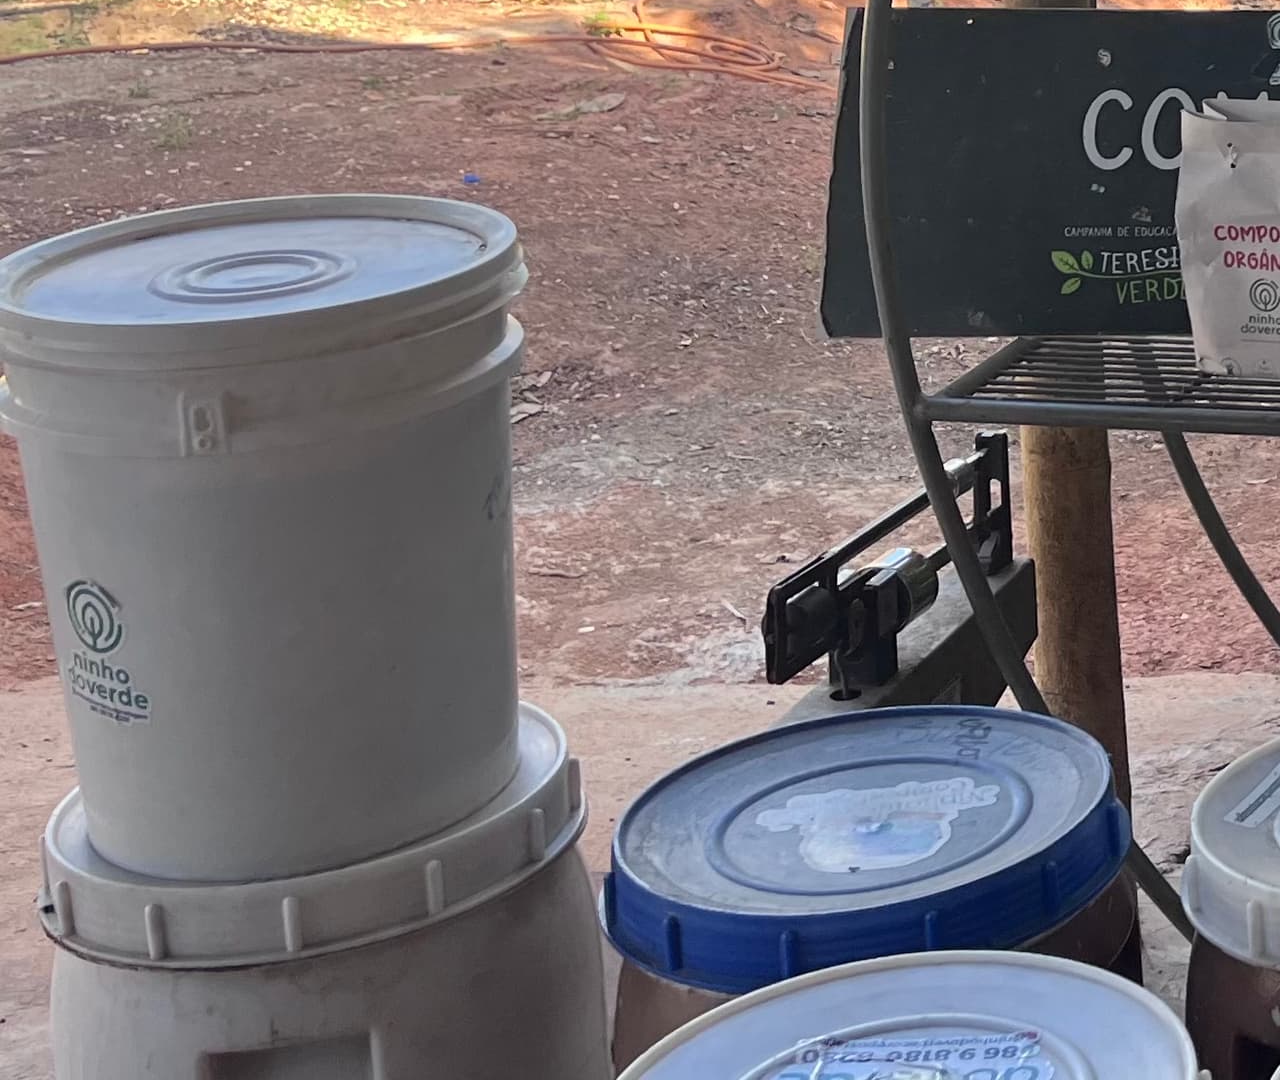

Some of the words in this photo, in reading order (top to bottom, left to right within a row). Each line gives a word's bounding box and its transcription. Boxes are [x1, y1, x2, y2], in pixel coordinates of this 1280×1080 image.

[1064, 226, 1112, 237] CAMPANHA
[1117, 226, 1130, 237] DE
[1100, 246, 1180, 274] TERESI
[73, 651, 130, 685] ninho
